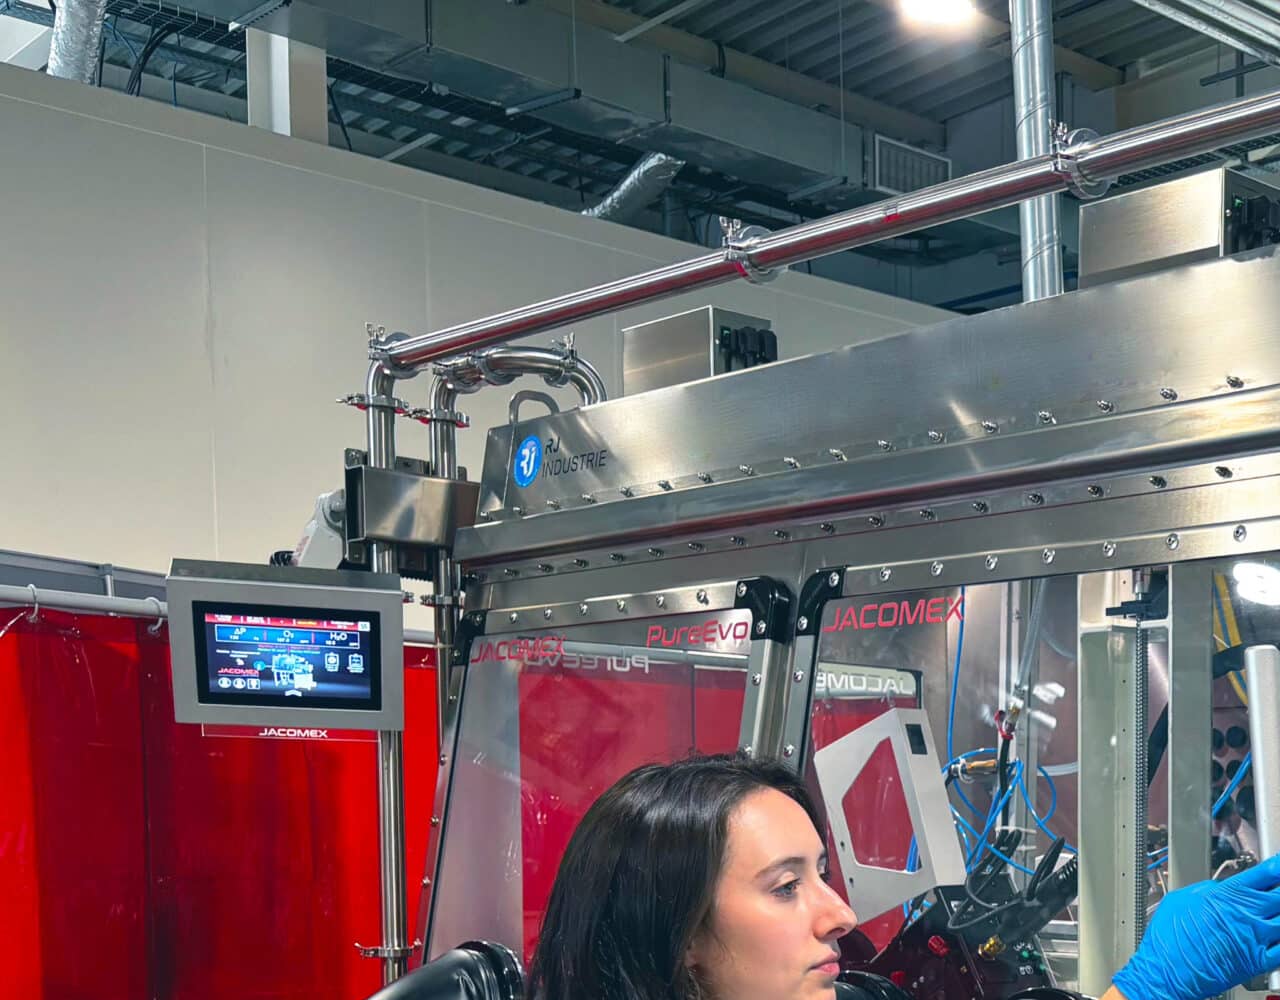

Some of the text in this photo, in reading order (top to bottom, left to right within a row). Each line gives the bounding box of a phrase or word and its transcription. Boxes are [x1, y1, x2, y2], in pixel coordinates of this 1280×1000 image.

[545, 437, 560, 454] RJ
[542, 450, 607, 478] INDUSTRIE
[822, 596, 964, 633] JACOMEX
[646, 620, 748, 648] PureEvo
[471, 634, 567, 664] JACOMEX
[258, 727, 329, 738] JACOMEX
